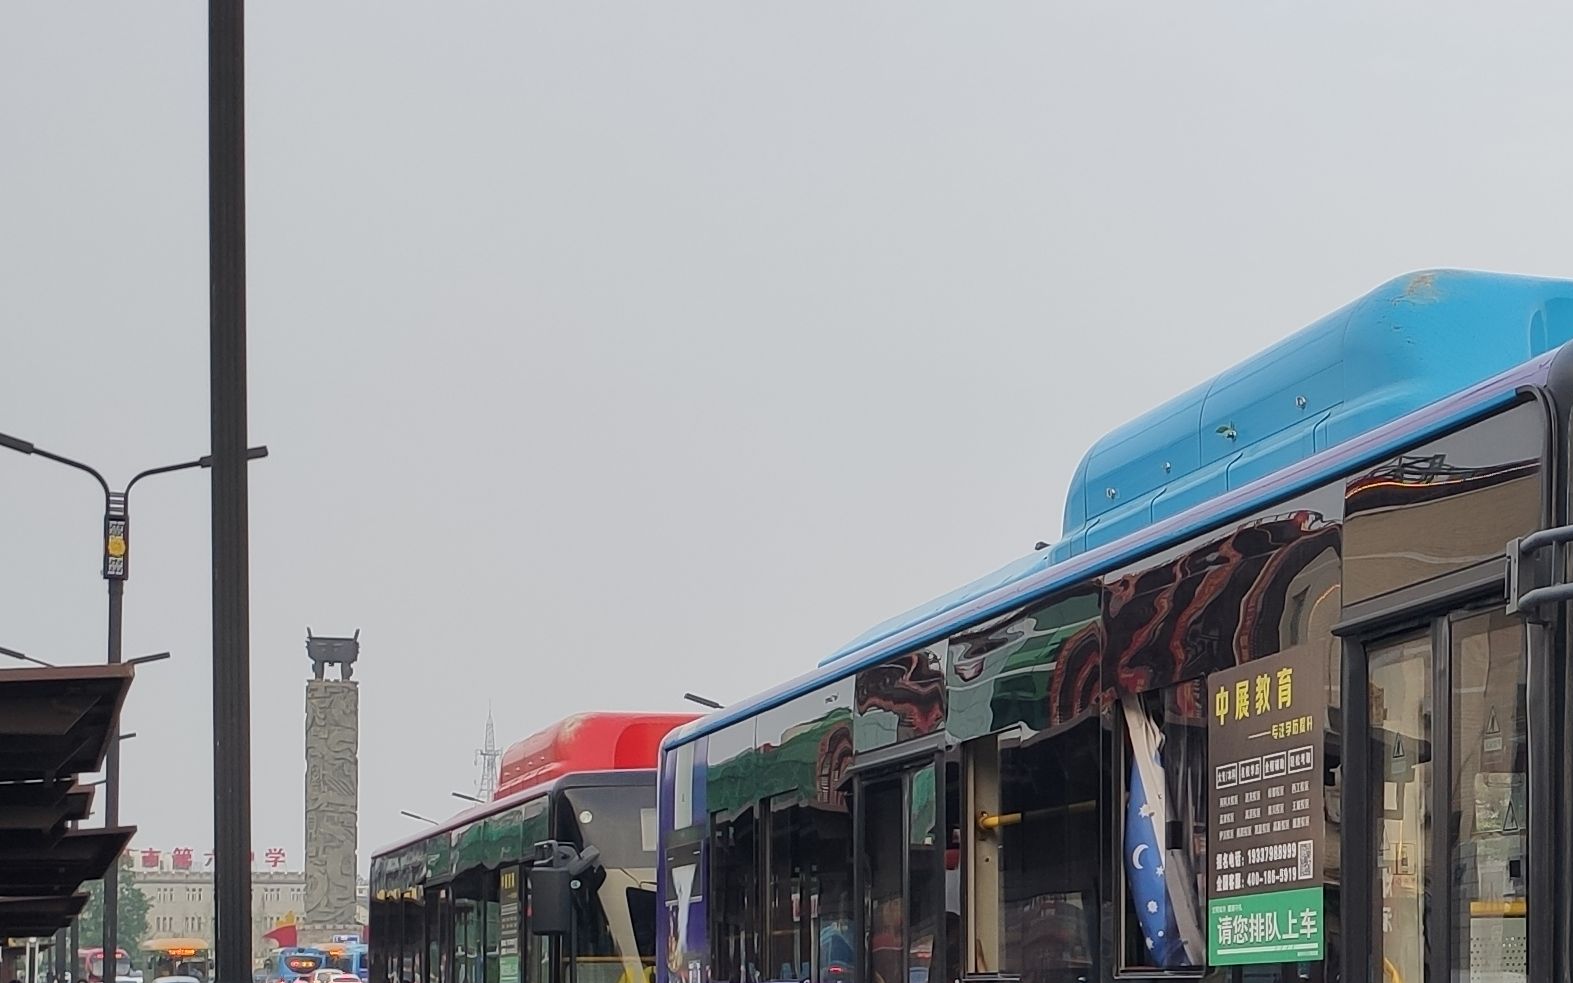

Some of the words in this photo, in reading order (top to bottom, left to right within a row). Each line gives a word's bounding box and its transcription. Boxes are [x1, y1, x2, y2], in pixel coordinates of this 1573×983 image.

[1215, 667, 1293, 726] 中展教育
[1217, 907, 1318, 945] 请您排队上车
